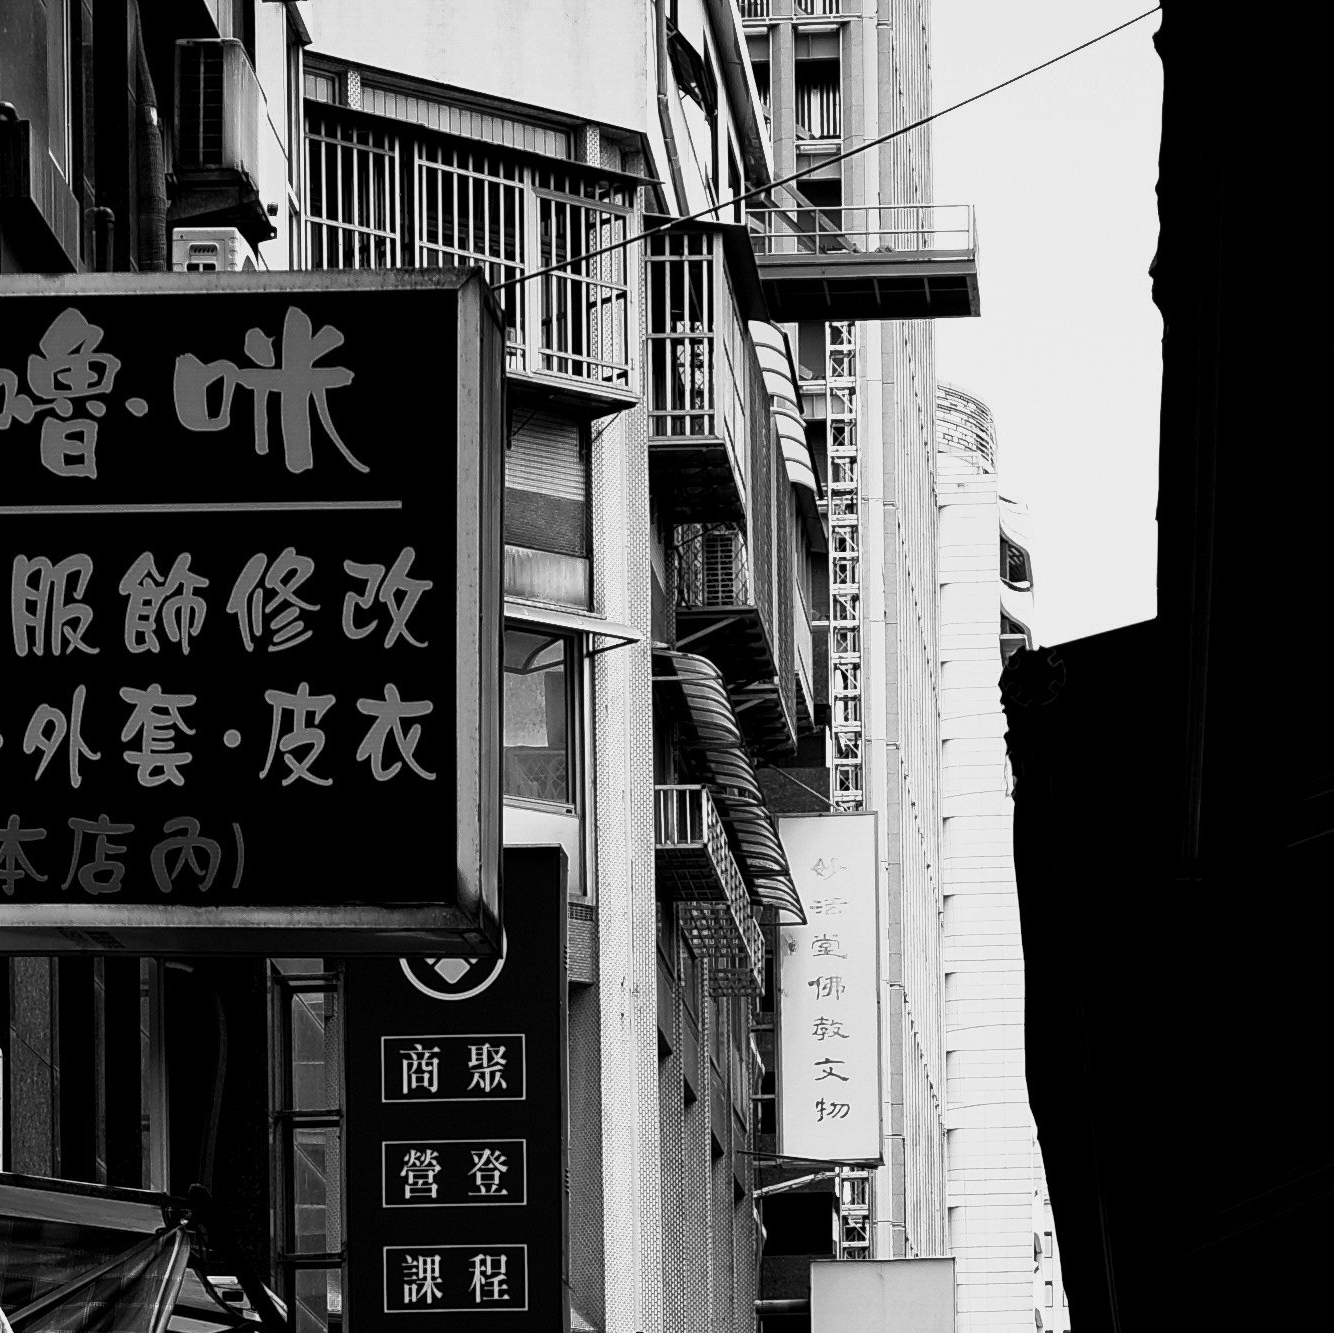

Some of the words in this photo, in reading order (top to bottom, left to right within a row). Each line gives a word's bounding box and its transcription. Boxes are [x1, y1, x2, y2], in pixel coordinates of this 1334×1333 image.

[399, 1042, 508, 1095] 商聚
[399, 1147, 509, 1200] 營登
[402, 1253, 512, 1306] 課程
